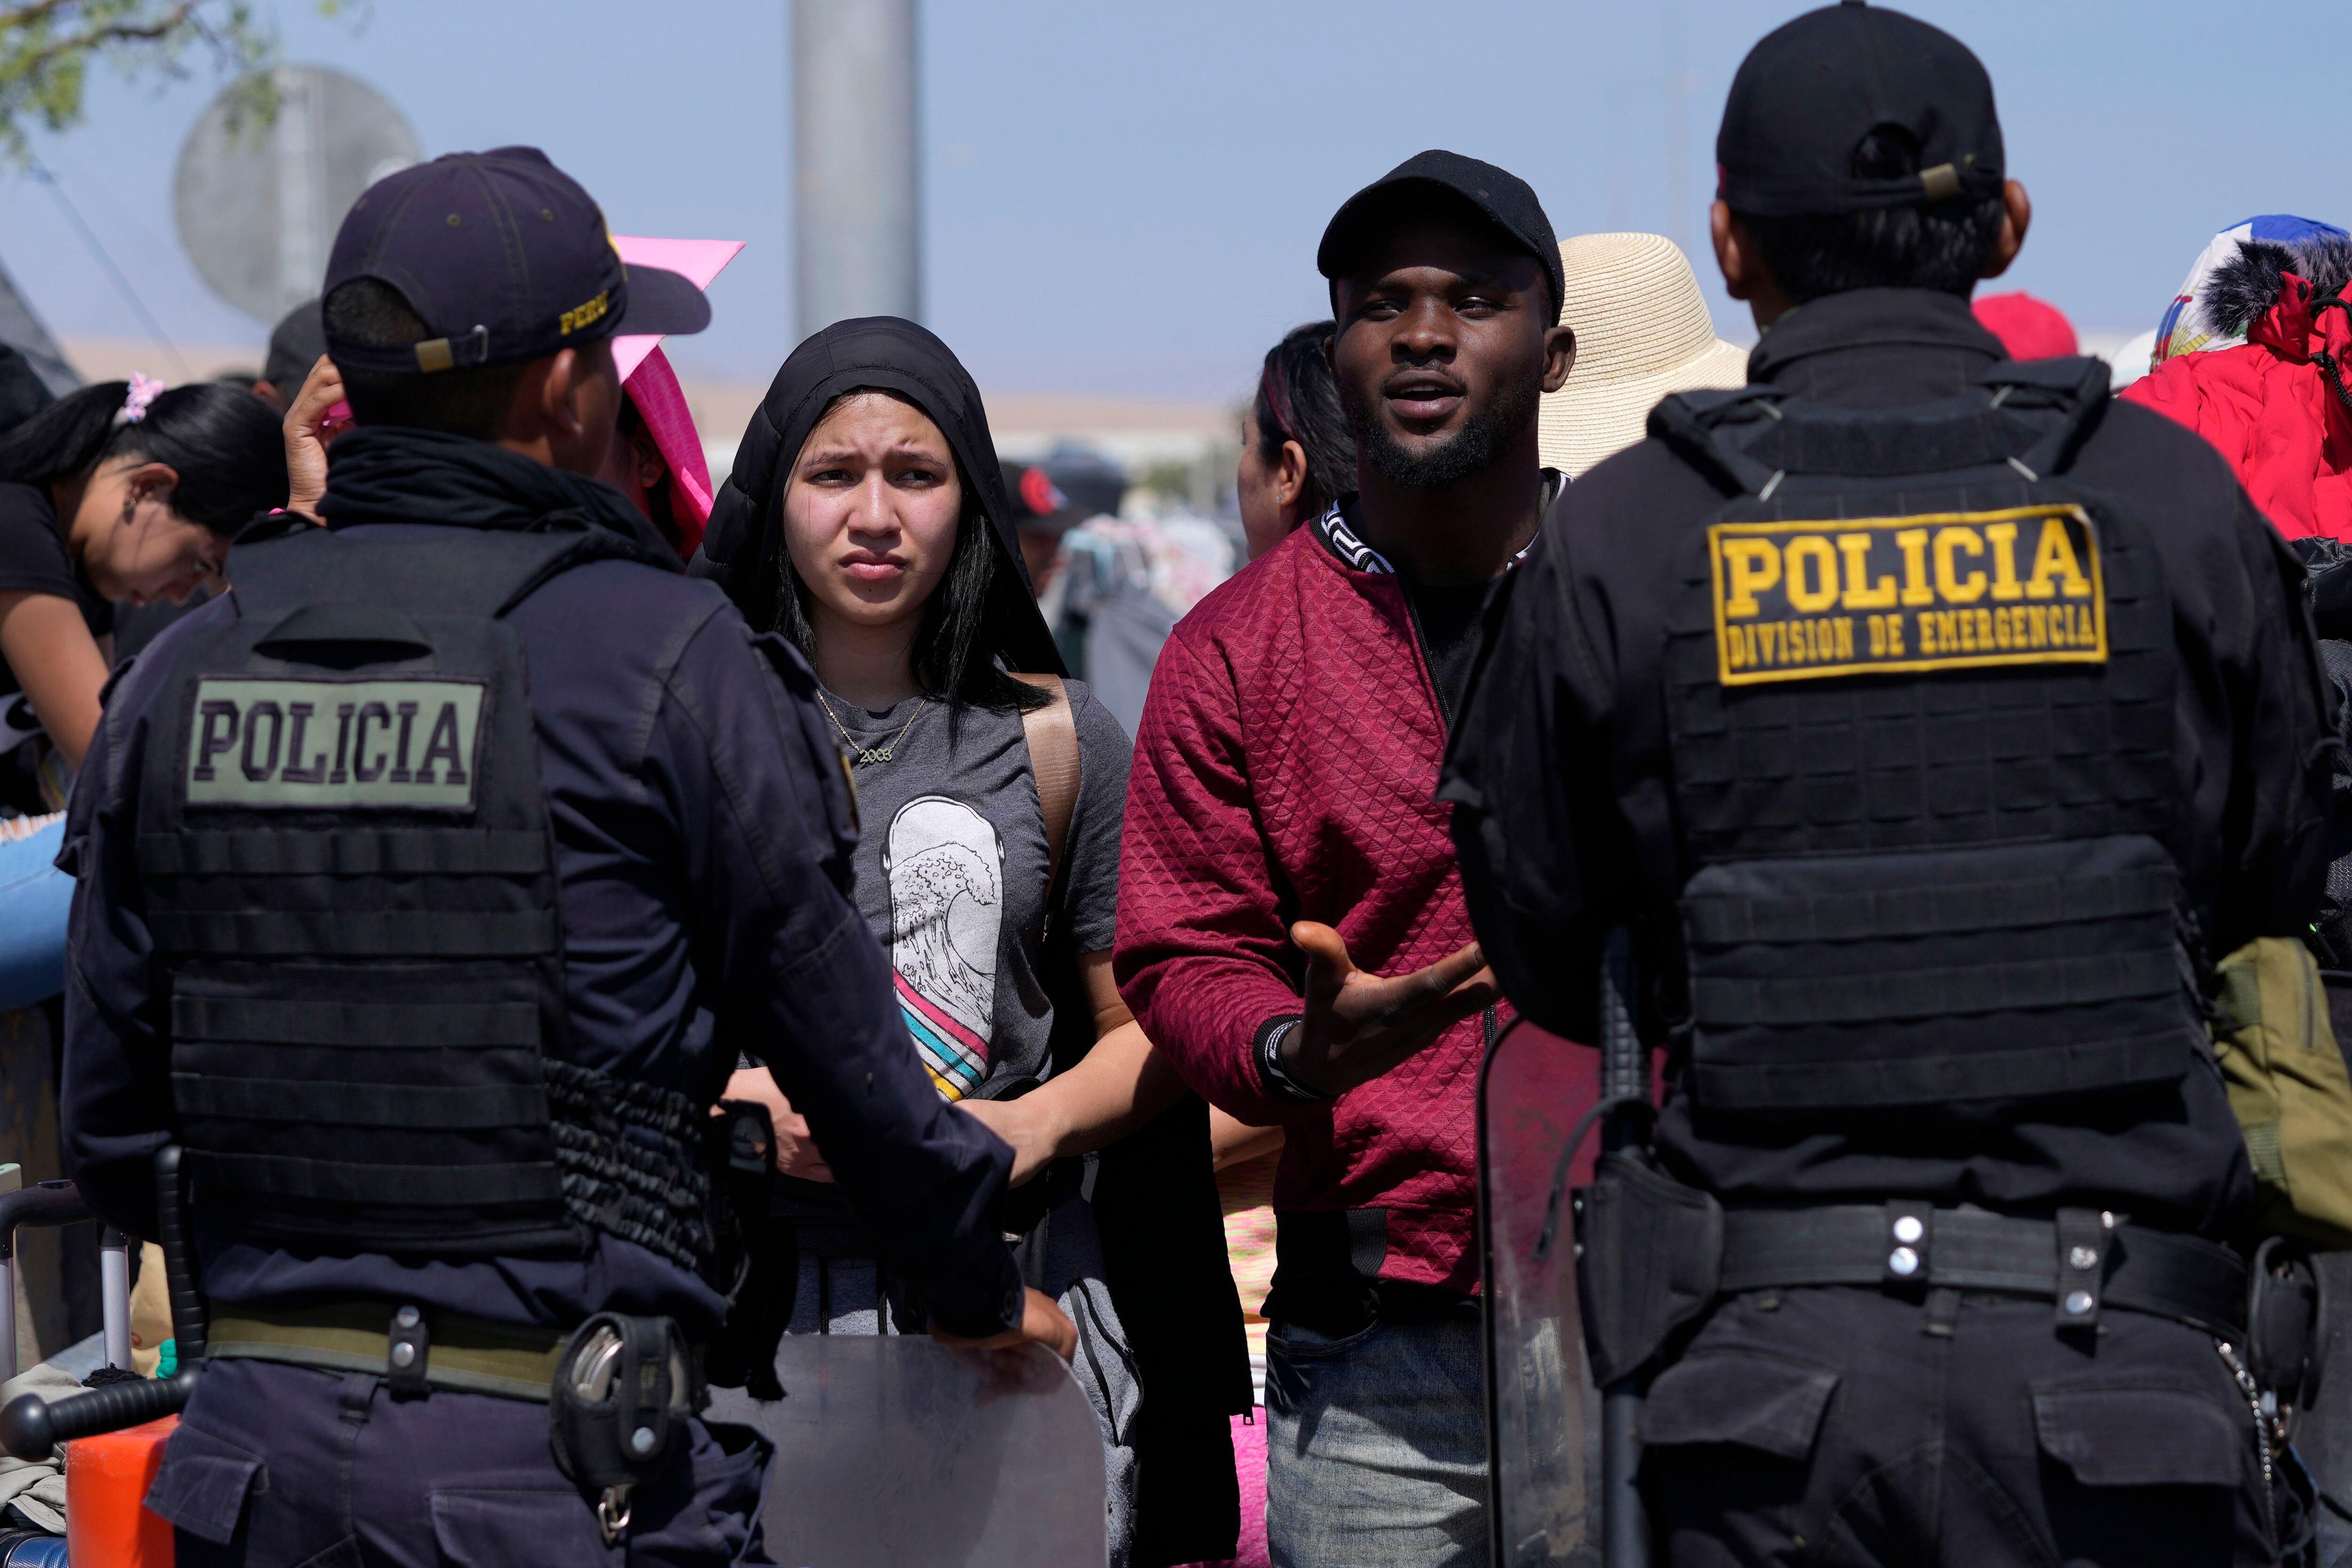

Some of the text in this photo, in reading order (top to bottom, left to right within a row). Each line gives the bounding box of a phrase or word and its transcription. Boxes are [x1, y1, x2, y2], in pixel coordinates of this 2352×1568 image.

[559, 289, 609, 335] PERU
[1722, 518, 2092, 617] POLICIA
[1727, 604, 2096, 669] DIVISION DE EMERGENCIA
[193, 700, 467, 784] POLICIA
[859, 748, 892, 763] 2003
